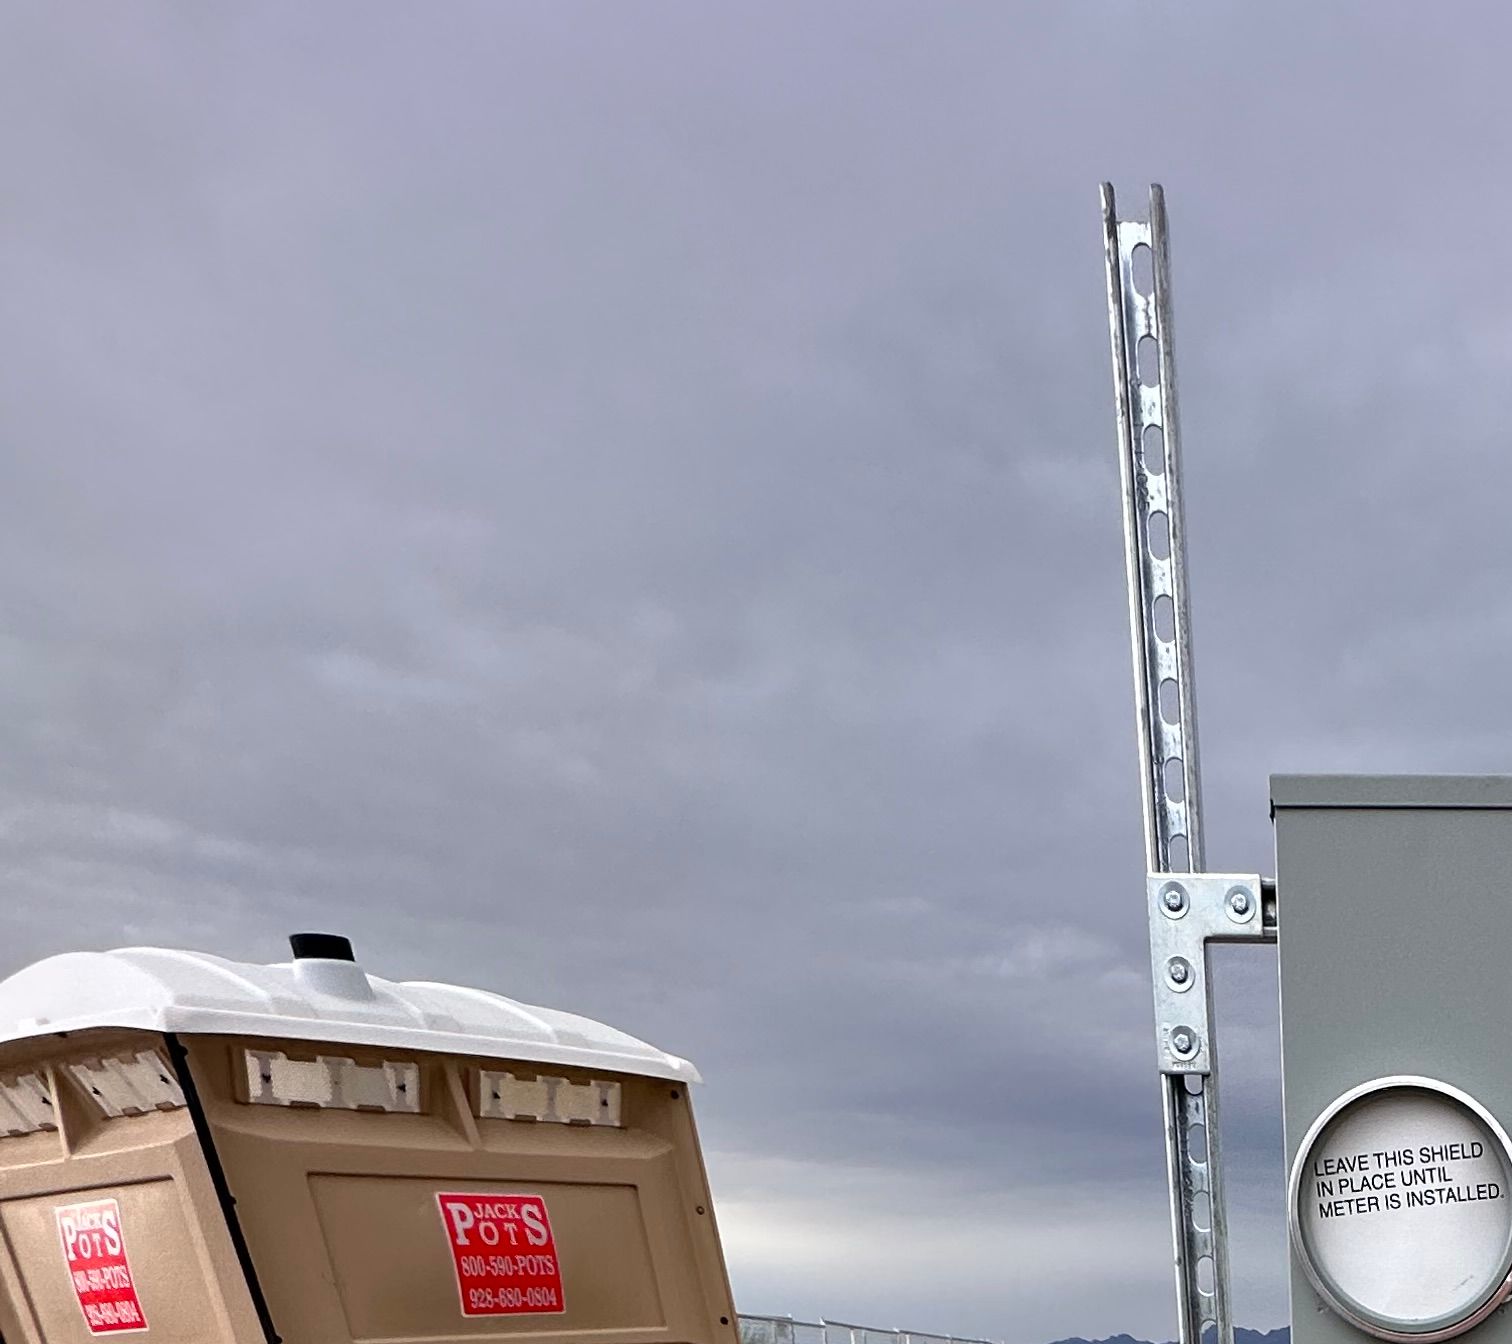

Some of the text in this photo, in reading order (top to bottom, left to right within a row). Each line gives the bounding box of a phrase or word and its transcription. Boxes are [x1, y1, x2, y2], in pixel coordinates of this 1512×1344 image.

[1314, 1142, 1483, 1176] LEAVE THIS SHIELD
[1317, 1167, 1453, 1197] IN PLACE UNTIL
[473, 1202, 521, 1219] JACK
[1319, 1183, 1505, 1218] METER IS INSTALLED.
[61, 1210, 121, 1261] POTS
[446, 1202, 548, 1246] POTS
[461, 1255, 555, 1277] 800-590-POTS
